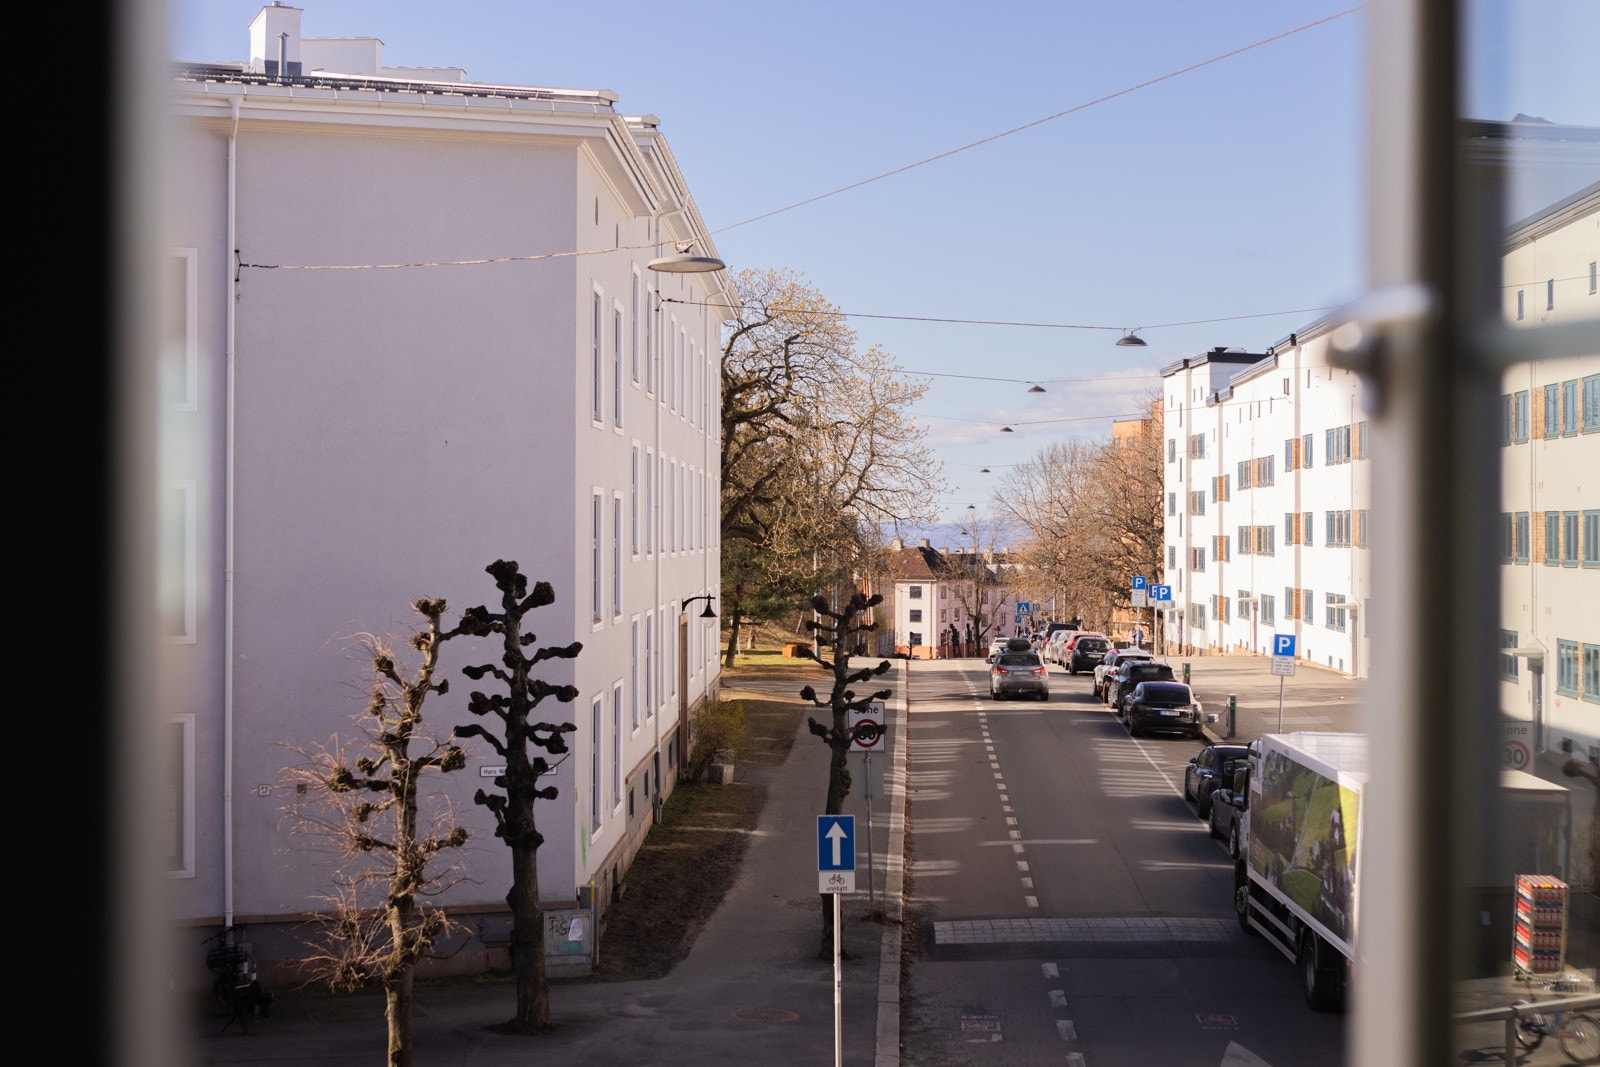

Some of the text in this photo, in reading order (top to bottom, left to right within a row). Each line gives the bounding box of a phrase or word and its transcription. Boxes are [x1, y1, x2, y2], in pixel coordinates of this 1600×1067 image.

[1135, 577, 1143, 588] P
[1159, 587, 1168, 599] P
[1278, 636, 1291, 654] P
[1503, 748, 1524, 765] 30
